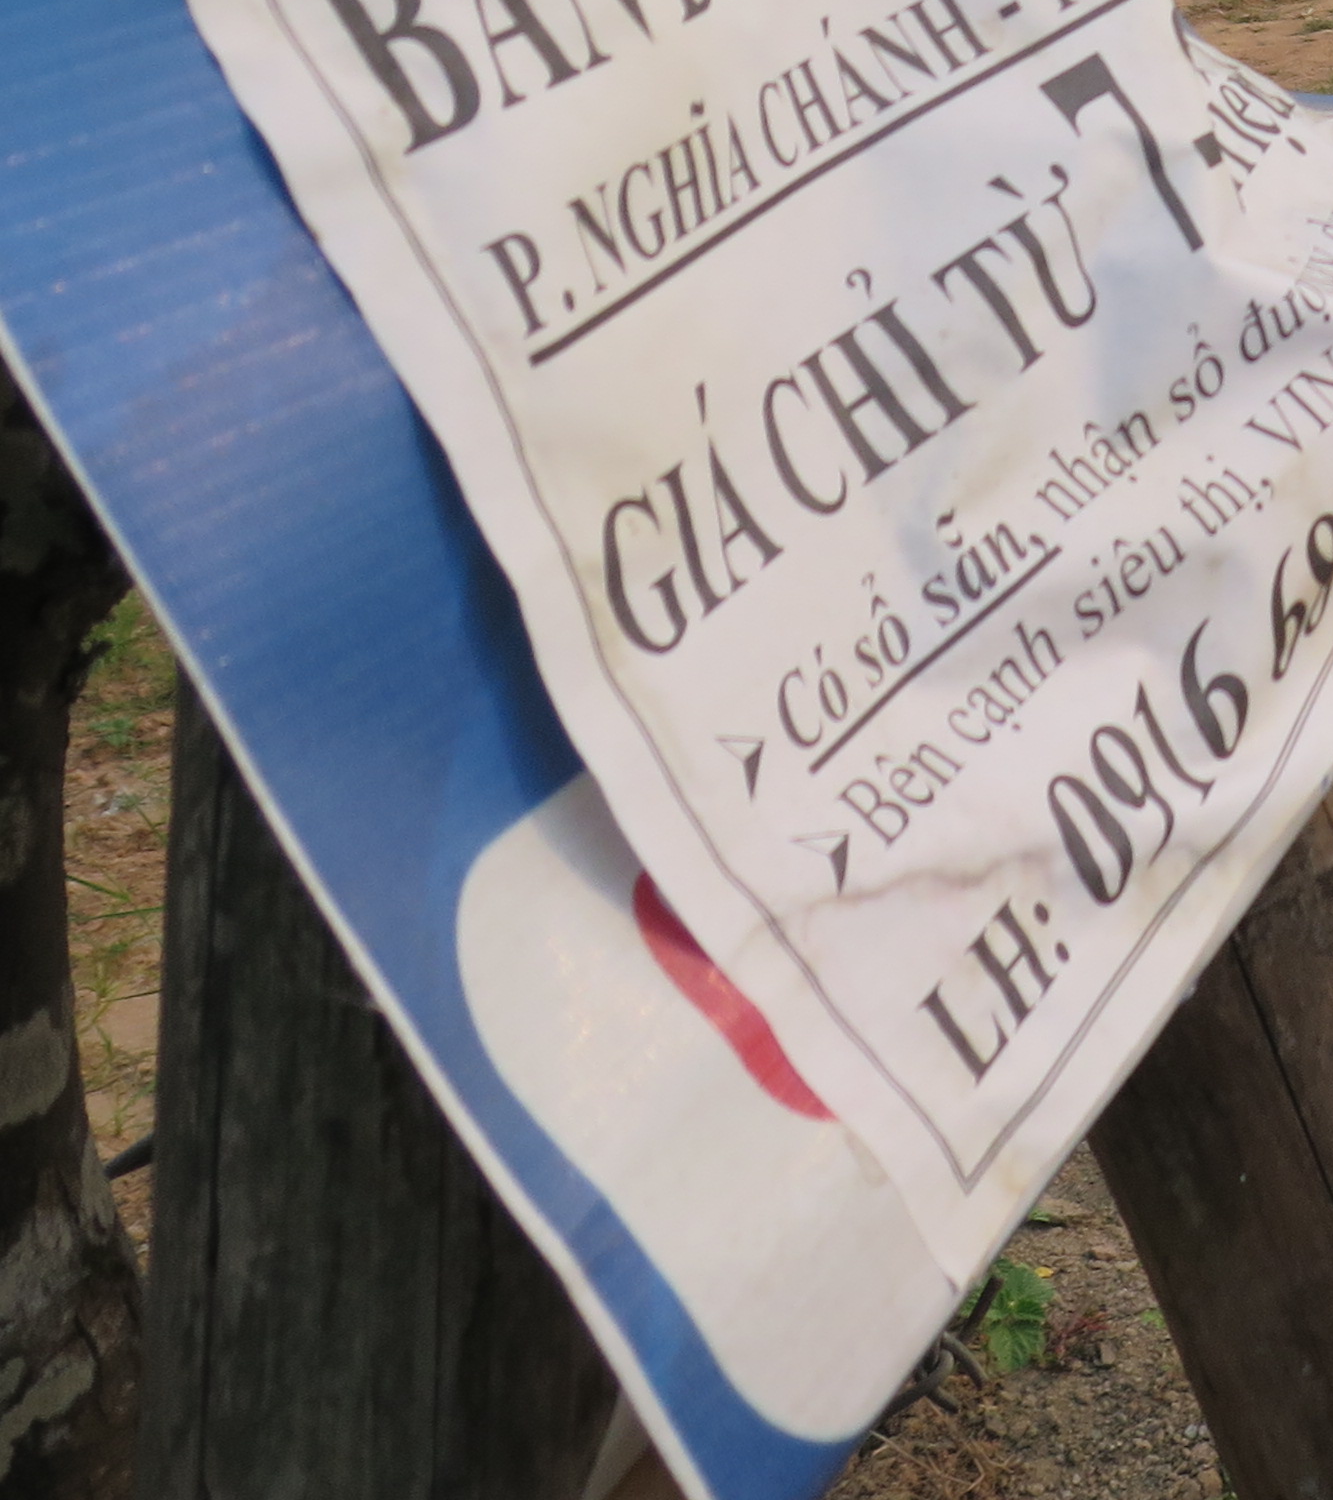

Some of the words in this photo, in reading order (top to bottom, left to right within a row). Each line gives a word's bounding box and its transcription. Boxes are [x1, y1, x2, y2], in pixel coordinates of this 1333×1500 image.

[568, 100, 762, 293] NGHĨA
[603, 382, 785, 655] GIÁ
[762, 268, 977, 515] CHỈ
[931, 164, 1097, 373] TỪ
[777, 644, 849, 748] Có
[854, 572, 911, 689] sổ
[922, 508, 1049, 627] sẵn,
[1036, 410, 1161, 521] nhận
[1169, 322, 1225, 422] sổ
[838, 741, 963, 847] Bên
[947, 621, 1065, 745] cạnh
[1073, 526, 1186, 640] siêu
[1179, 453, 1275, 537] thị,
[916, 897, 1070, 1085] LH:
